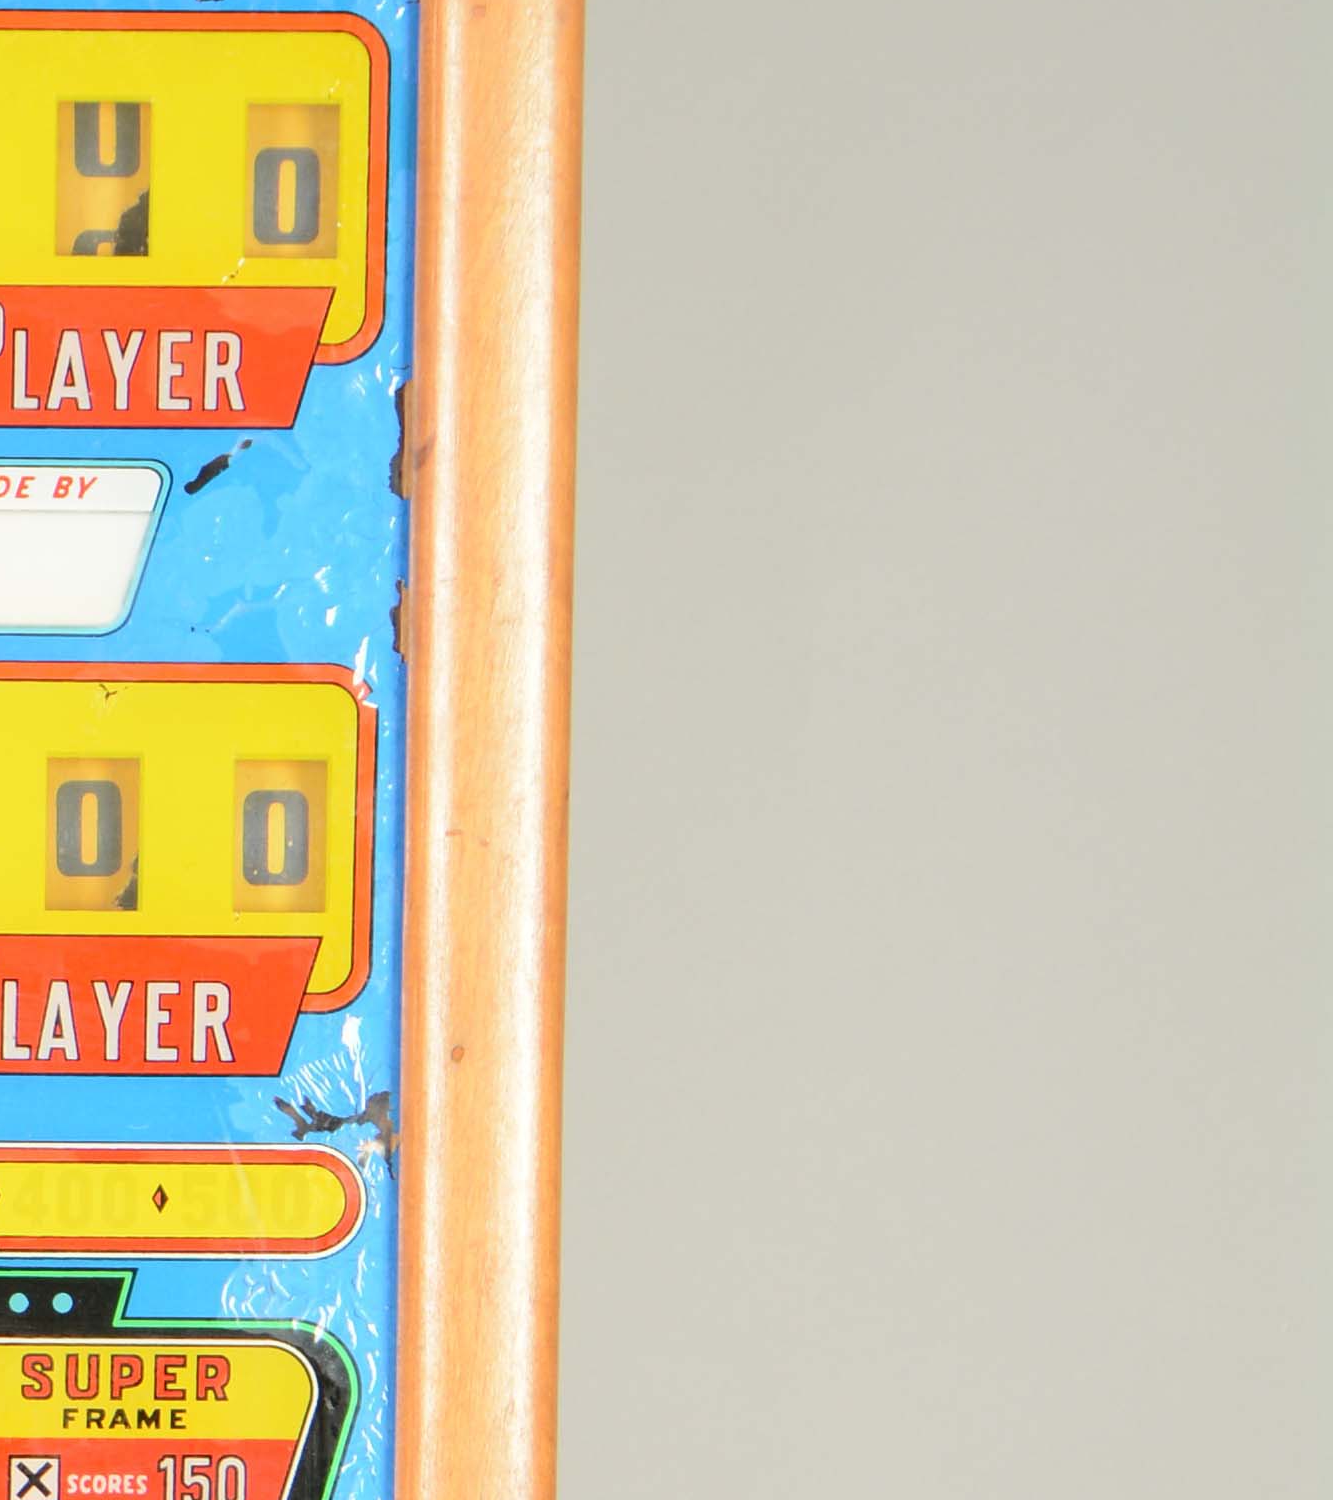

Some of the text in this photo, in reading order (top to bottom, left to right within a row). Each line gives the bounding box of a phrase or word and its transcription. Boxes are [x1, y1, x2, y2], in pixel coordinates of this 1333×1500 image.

[253, 146, 321, 246] 0
[52, 476, 99, 499] BY
[55, 780, 123, 877] 0
[242, 789, 309, 887] 0
[21, 1353, 230, 1401] SUPER
[62, 1408, 187, 1430] FRAME
[66, 1473, 148, 1495] SCORES
